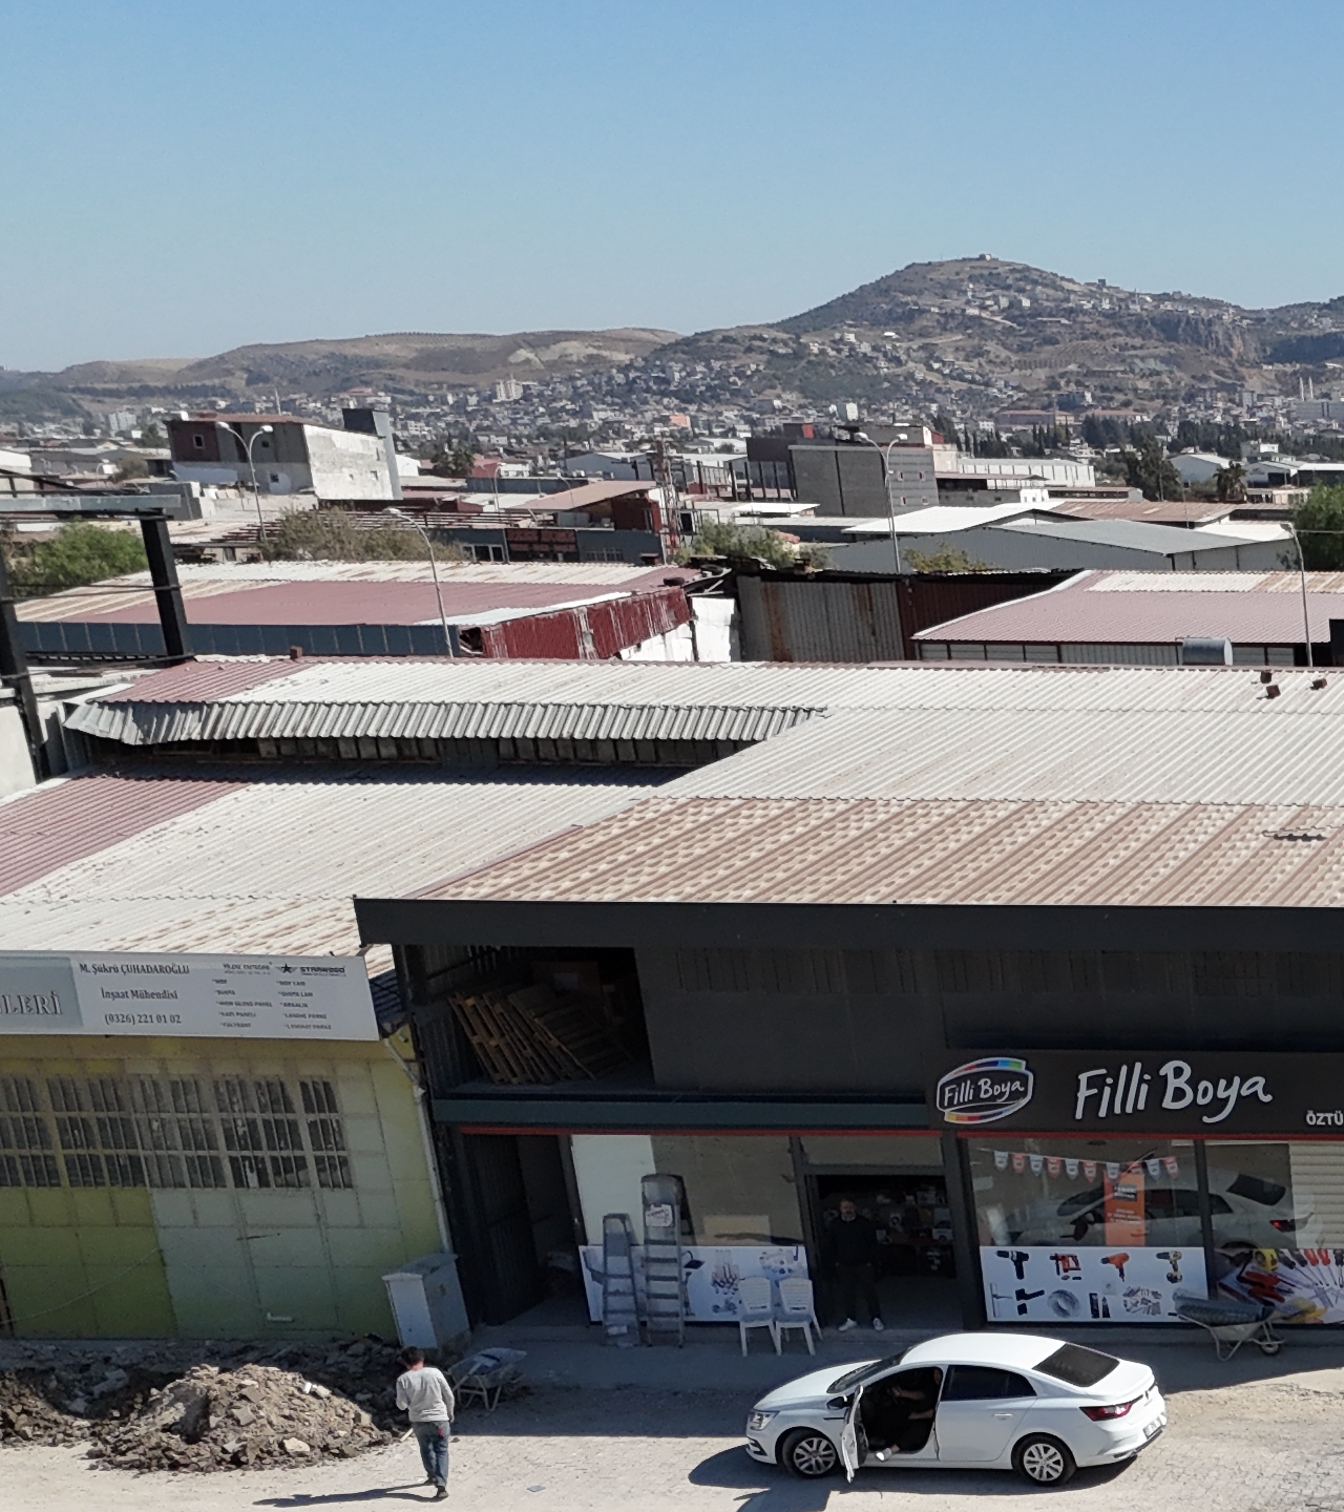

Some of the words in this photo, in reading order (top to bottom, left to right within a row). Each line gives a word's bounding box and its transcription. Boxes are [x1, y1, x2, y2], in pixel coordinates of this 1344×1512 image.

[104, 1013, 136, 1026] (0326)
[137, 1014, 154, 1024] 221
[156, 1014, 167, 1024] 01
[170, 1014, 182, 1024] 02
[944, 1081, 975, 1106] Filli
[978, 1078, 1025, 1103] Boya
[1075, 1062, 1152, 1120] Filli
[1159, 1059, 1273, 1125] Boya
